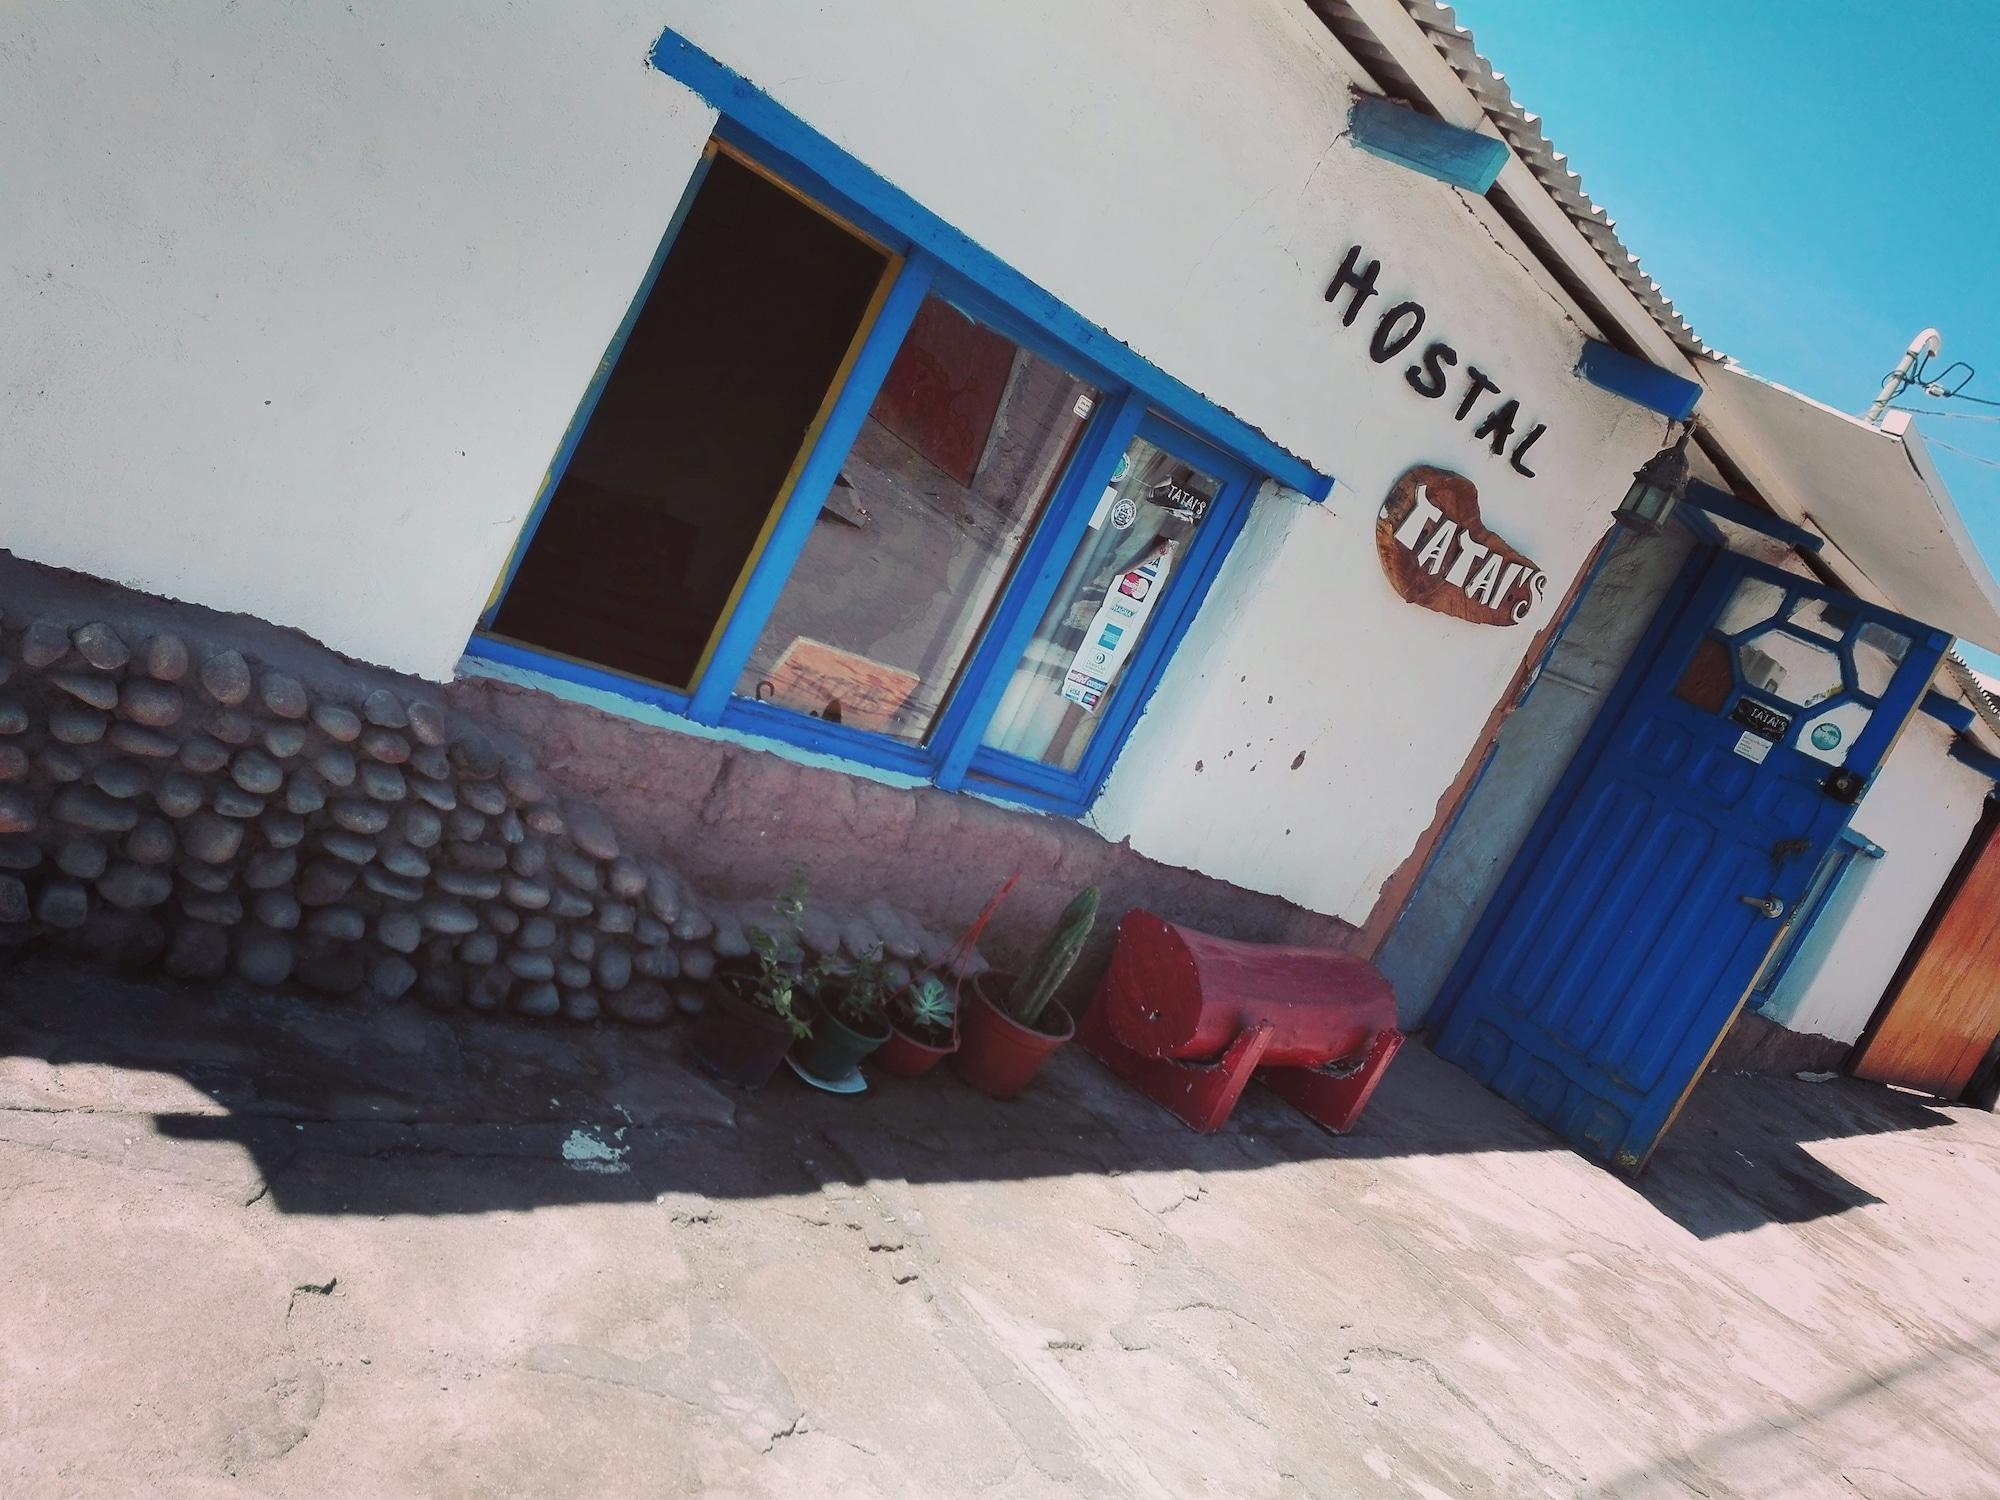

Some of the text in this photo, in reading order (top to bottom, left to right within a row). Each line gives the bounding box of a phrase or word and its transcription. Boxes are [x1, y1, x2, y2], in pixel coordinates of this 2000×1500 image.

[1325, 245, 1548, 478] HOSTAL
[1166, 484, 1207, 516] TATAI'S
[1394, 484, 1548, 624] TATAI'S
